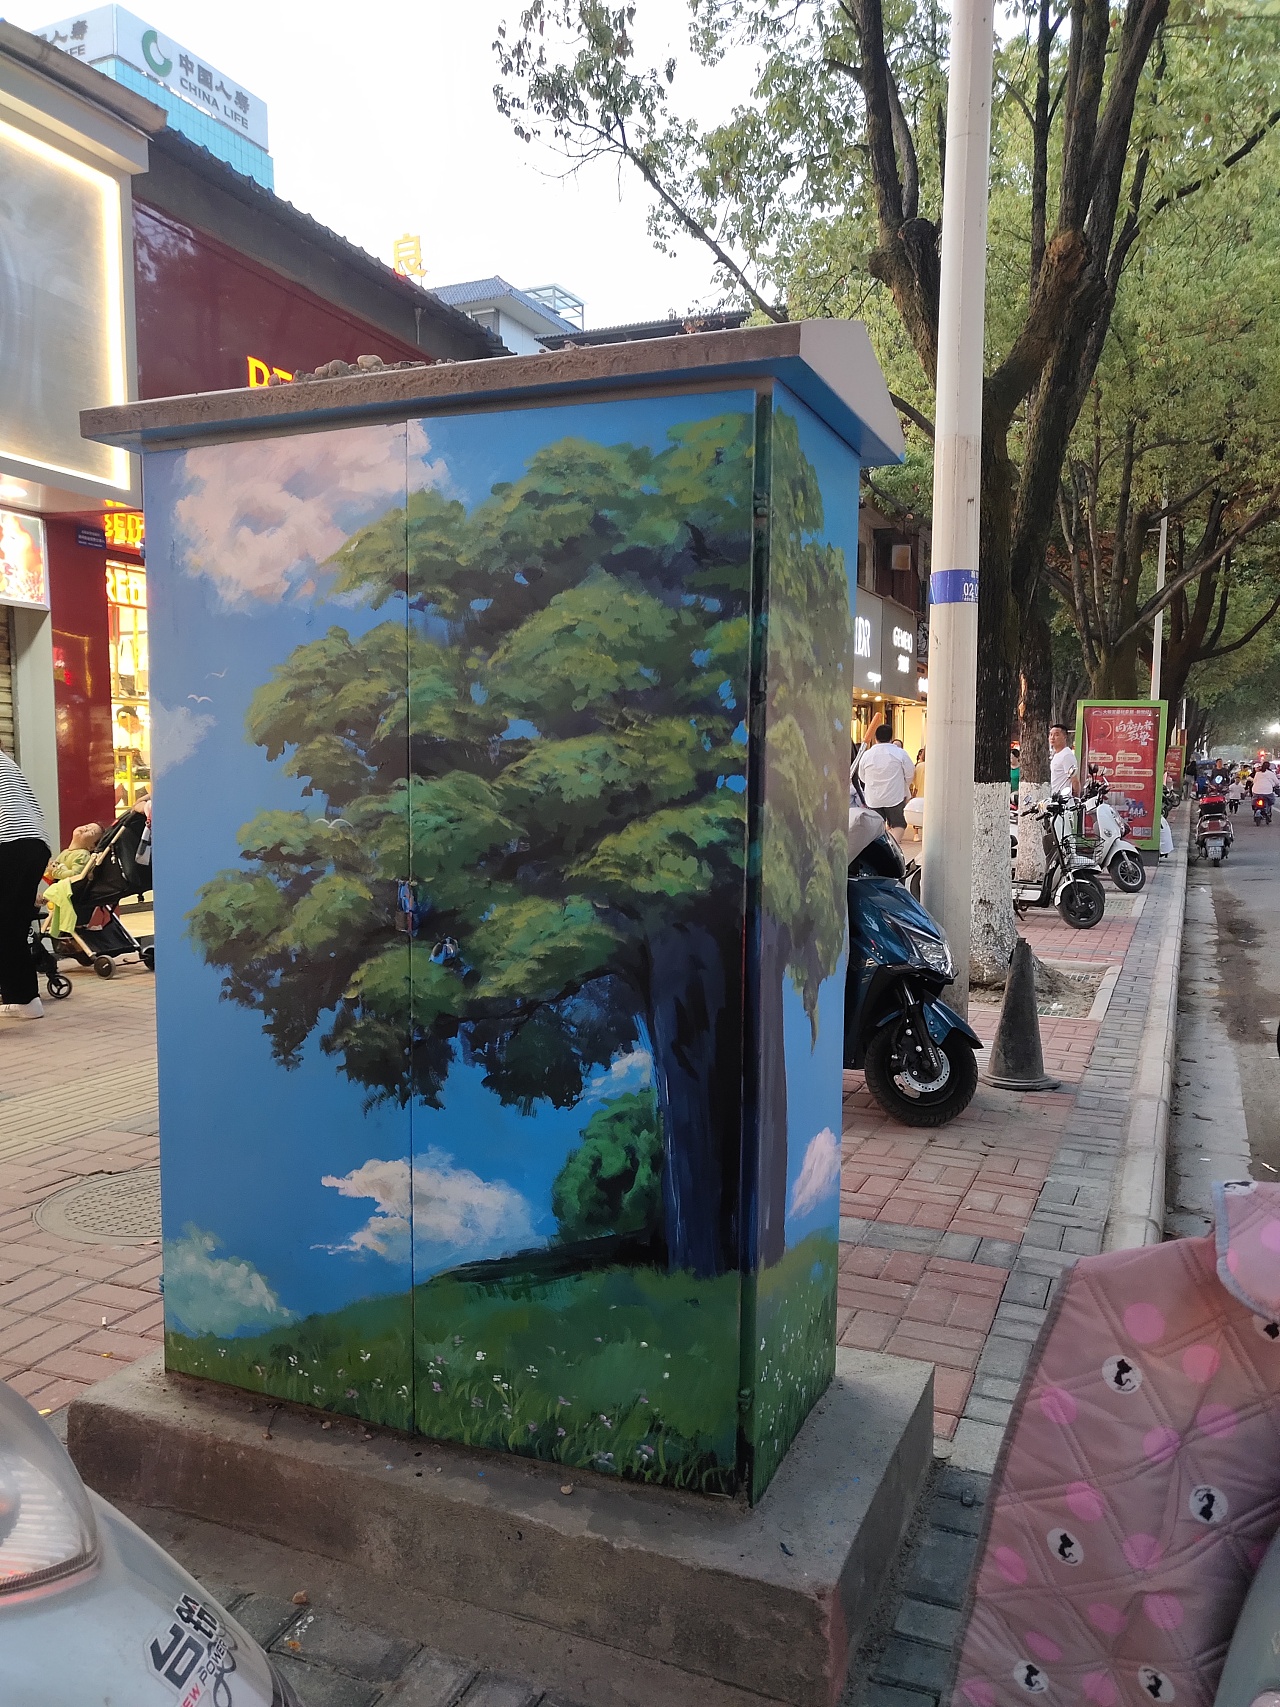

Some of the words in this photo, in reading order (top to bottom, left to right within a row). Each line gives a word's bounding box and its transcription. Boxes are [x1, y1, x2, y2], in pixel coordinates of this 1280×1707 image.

[179, 53, 250, 114] 中国人寿
[180, 77, 219, 111] CHINA
[224, 105, 248, 130] LIFE
[393, 233, 427, 277] 良
[199, 1638, 228, 1686] POWER
